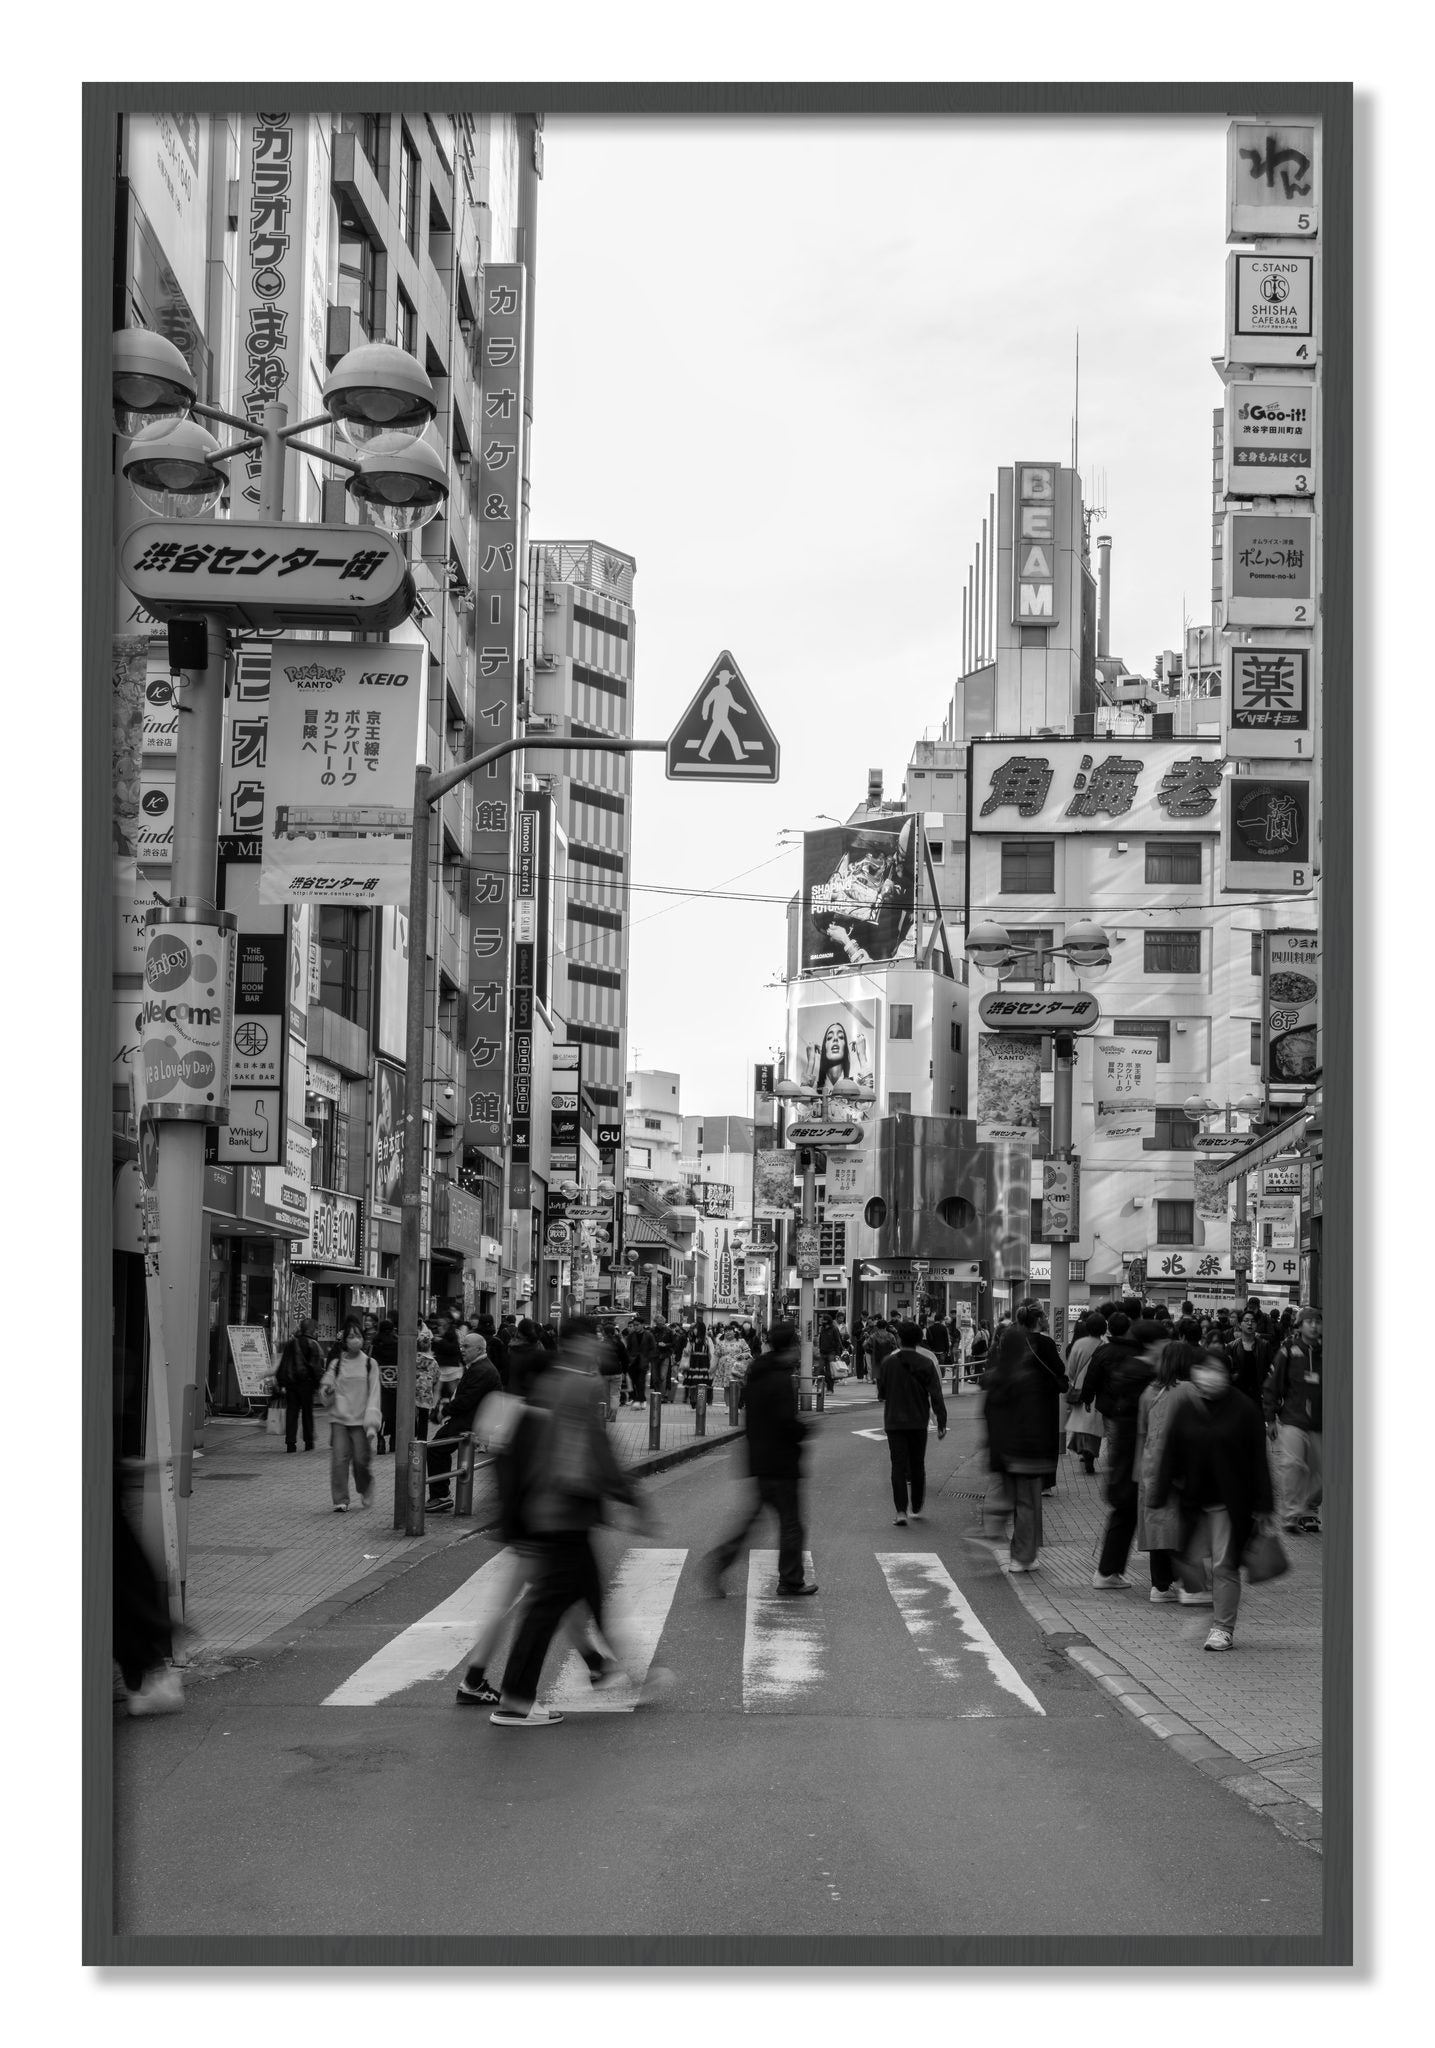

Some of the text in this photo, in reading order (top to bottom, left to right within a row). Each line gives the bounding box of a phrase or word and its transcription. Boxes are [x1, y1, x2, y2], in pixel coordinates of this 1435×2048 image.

[250, 127, 293, 269] カラオケ
[1297, 214, 1310, 230] 5
[1251, 263, 1298, 272] C.STAND
[1251, 305, 1298, 316] SHISHA
[1251, 316, 1298, 325] CAFE&BAR
[1250, 405, 1306, 421] Goo-it!
[1243, 425, 1303, 435] 渋谷宇田川町店
[1238, 451, 1307, 463] 全身もみほぐし
[1295, 475, 1307, 492] 3
[1020, 467, 1054, 617] BEAM
[133, 542, 390, 580] 渋谷センター街
[1239, 548, 1304, 568] ポムの樹
[1249, 572, 1296, 580] Pomme-no-ki
[1294, 605, 1307, 622] 2
[297, 681, 333, 689] KANTO
[358, 672, 409, 687] KEIO
[1242, 656, 1294, 708] 薬
[302, 709, 319, 753] 冒険へ
[320, 709, 339, 786] カントーの
[341, 709, 361, 786] ポケパーク
[364, 711, 382, 771] 京王線で
[1294, 738, 1302, 753] 1
[979, 755, 1225, 818] 角海老
[1236, 795, 1299, 845] 一蘭
[521, 816, 531, 893] kimono hearts
[288, 877, 380, 890] 渋谷センター街
[1293, 870, 1305, 886] B
[146, 948, 188, 984] Enjoy
[242, 954, 265, 962] THIRD
[143, 1000, 222, 1026] Welcome
[986, 1001, 1093, 1015] 渋谷センター街
[1270, 1010, 1300, 1031] 6F
[173, 1021, 191, 1042] Shibuya
[160, 1060, 192, 1081] Lovely
[193, 1060, 214, 1076] Day!
[229, 1127, 264, 1139] Whisky
[600, 1131, 620, 1142] GU
[229, 1138, 250, 1146] Bank
[1161, 1253, 1222, 1276] 兆楽
[722, 1251, 731, 1296] BEER
[718, 1297, 732, 1305] HALL
